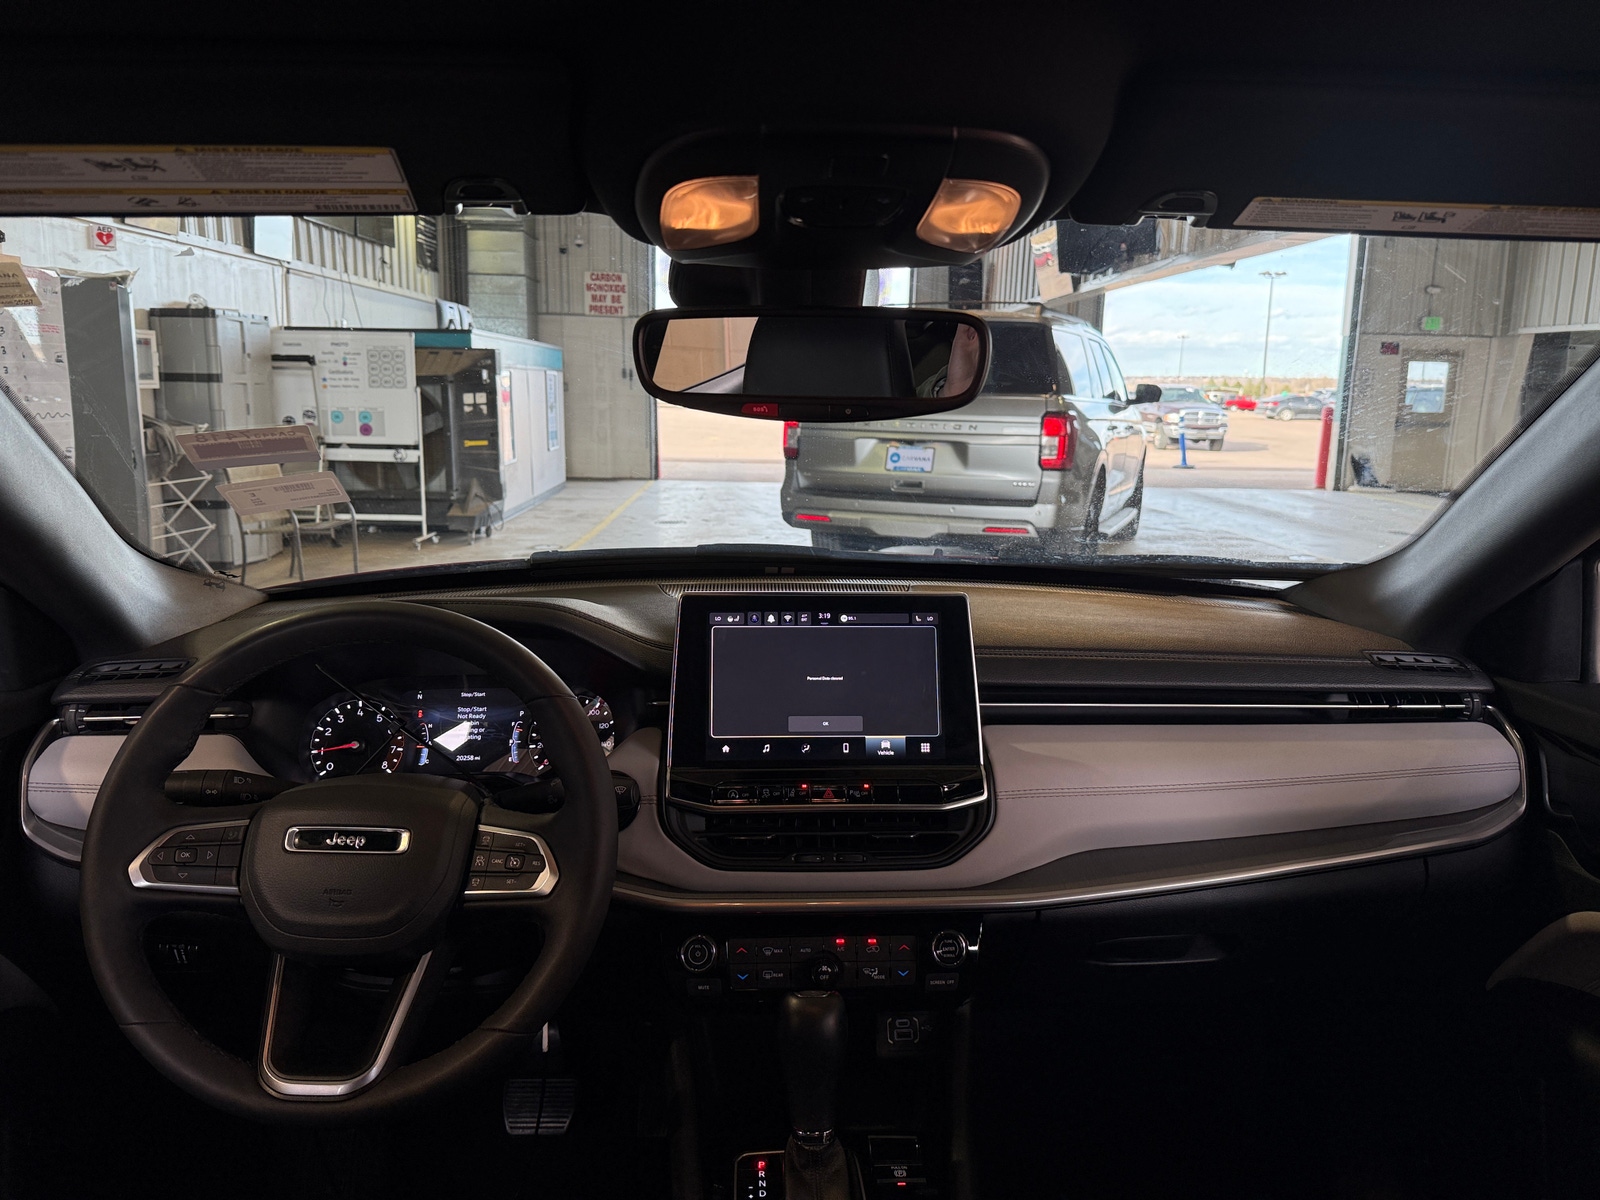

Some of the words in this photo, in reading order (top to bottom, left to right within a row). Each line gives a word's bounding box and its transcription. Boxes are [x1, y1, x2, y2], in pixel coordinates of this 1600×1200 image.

[590, 272, 622, 282] CARBON
[591, 293, 607, 303] MAY
[611, 294, 622, 304] BE
[589, 304, 624, 315] PRESENT
[357, 709, 364, 717] 4
[337, 714, 345, 723] 3
[376, 714, 383, 723] 5
[324, 727, 332, 736] 2
[390, 745, 397, 754] 7
[326, 761, 334, 771] 0
[381, 760, 388, 770] 8
[325, 831, 367, 849] Jeep
[322, 888, 353, 896] AIRBAG
[757, 1161, 766, 1169] P
[758, 1179, 767, 1187] N
[759, 1190, 767, 1198] D
